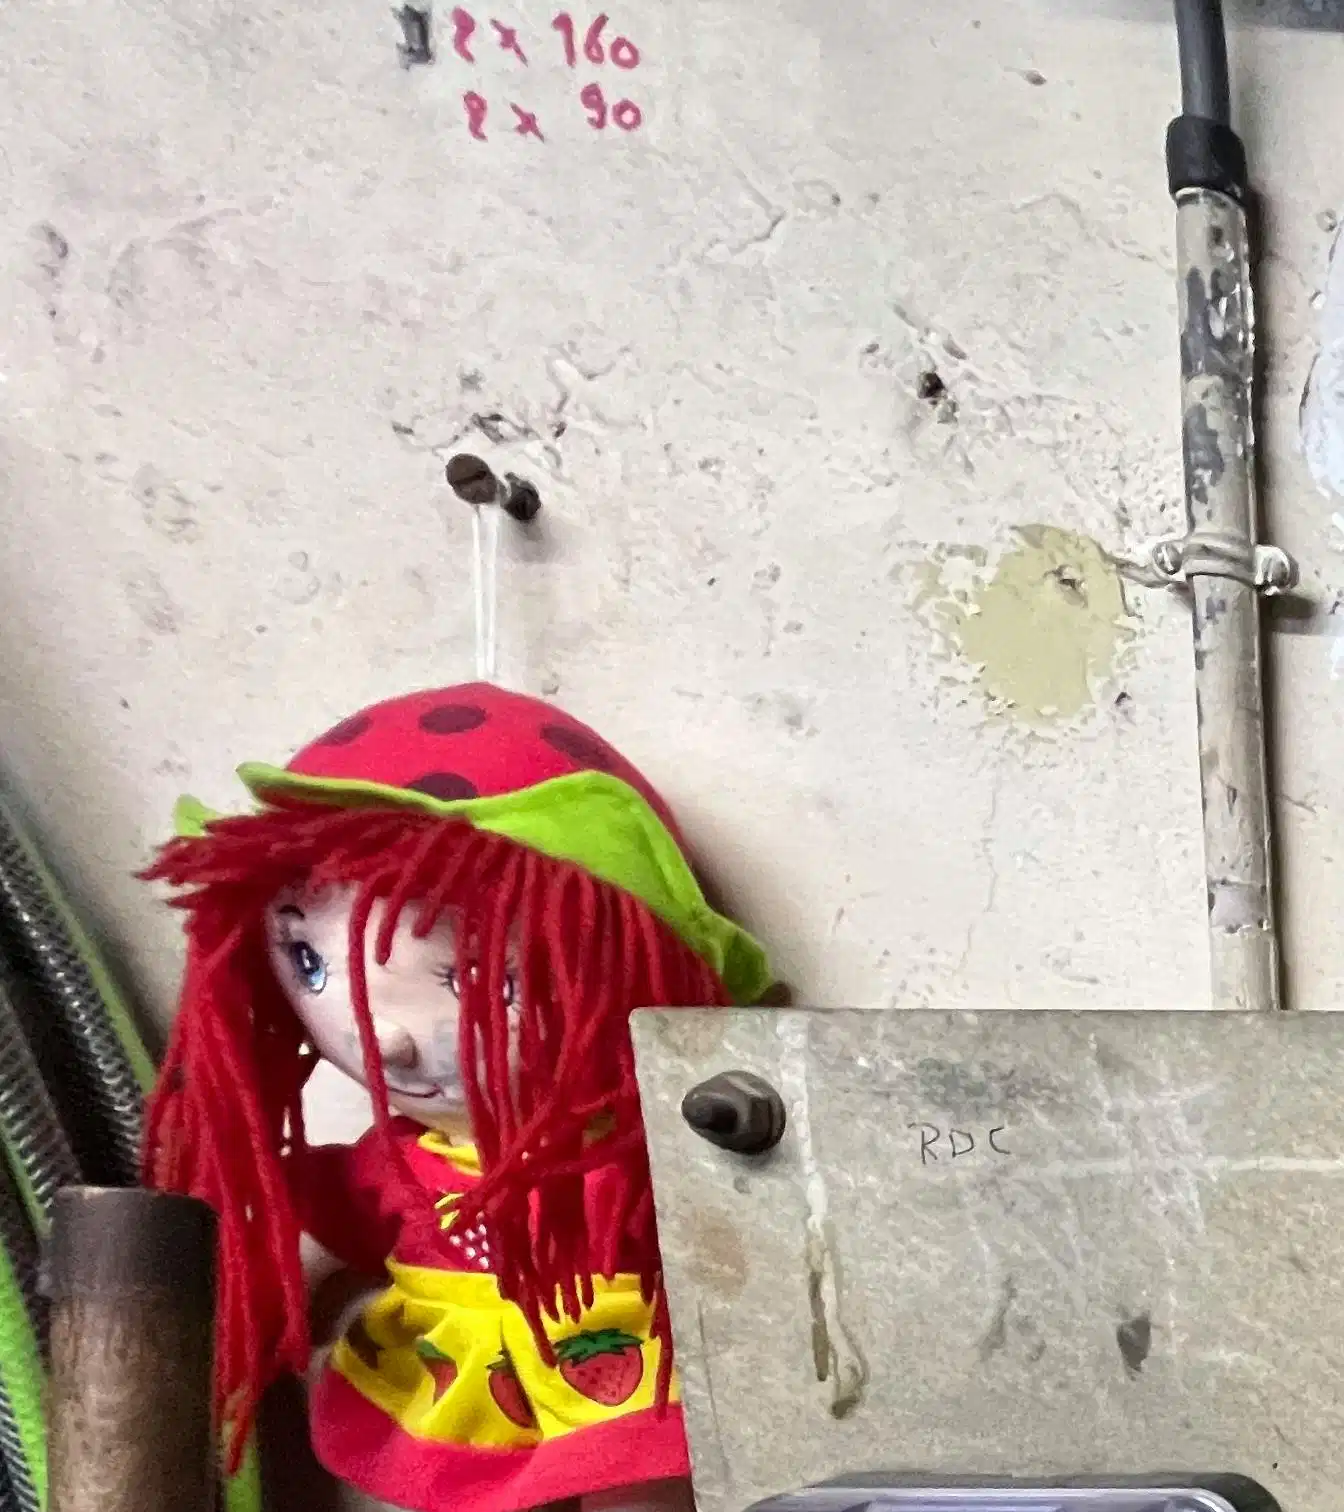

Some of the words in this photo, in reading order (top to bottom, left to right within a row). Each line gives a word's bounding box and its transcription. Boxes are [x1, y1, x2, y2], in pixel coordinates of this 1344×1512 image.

[553, 13, 640, 69] 160
[581, 83, 641, 131] 90
[908, 1122, 1011, 1165] RDC
